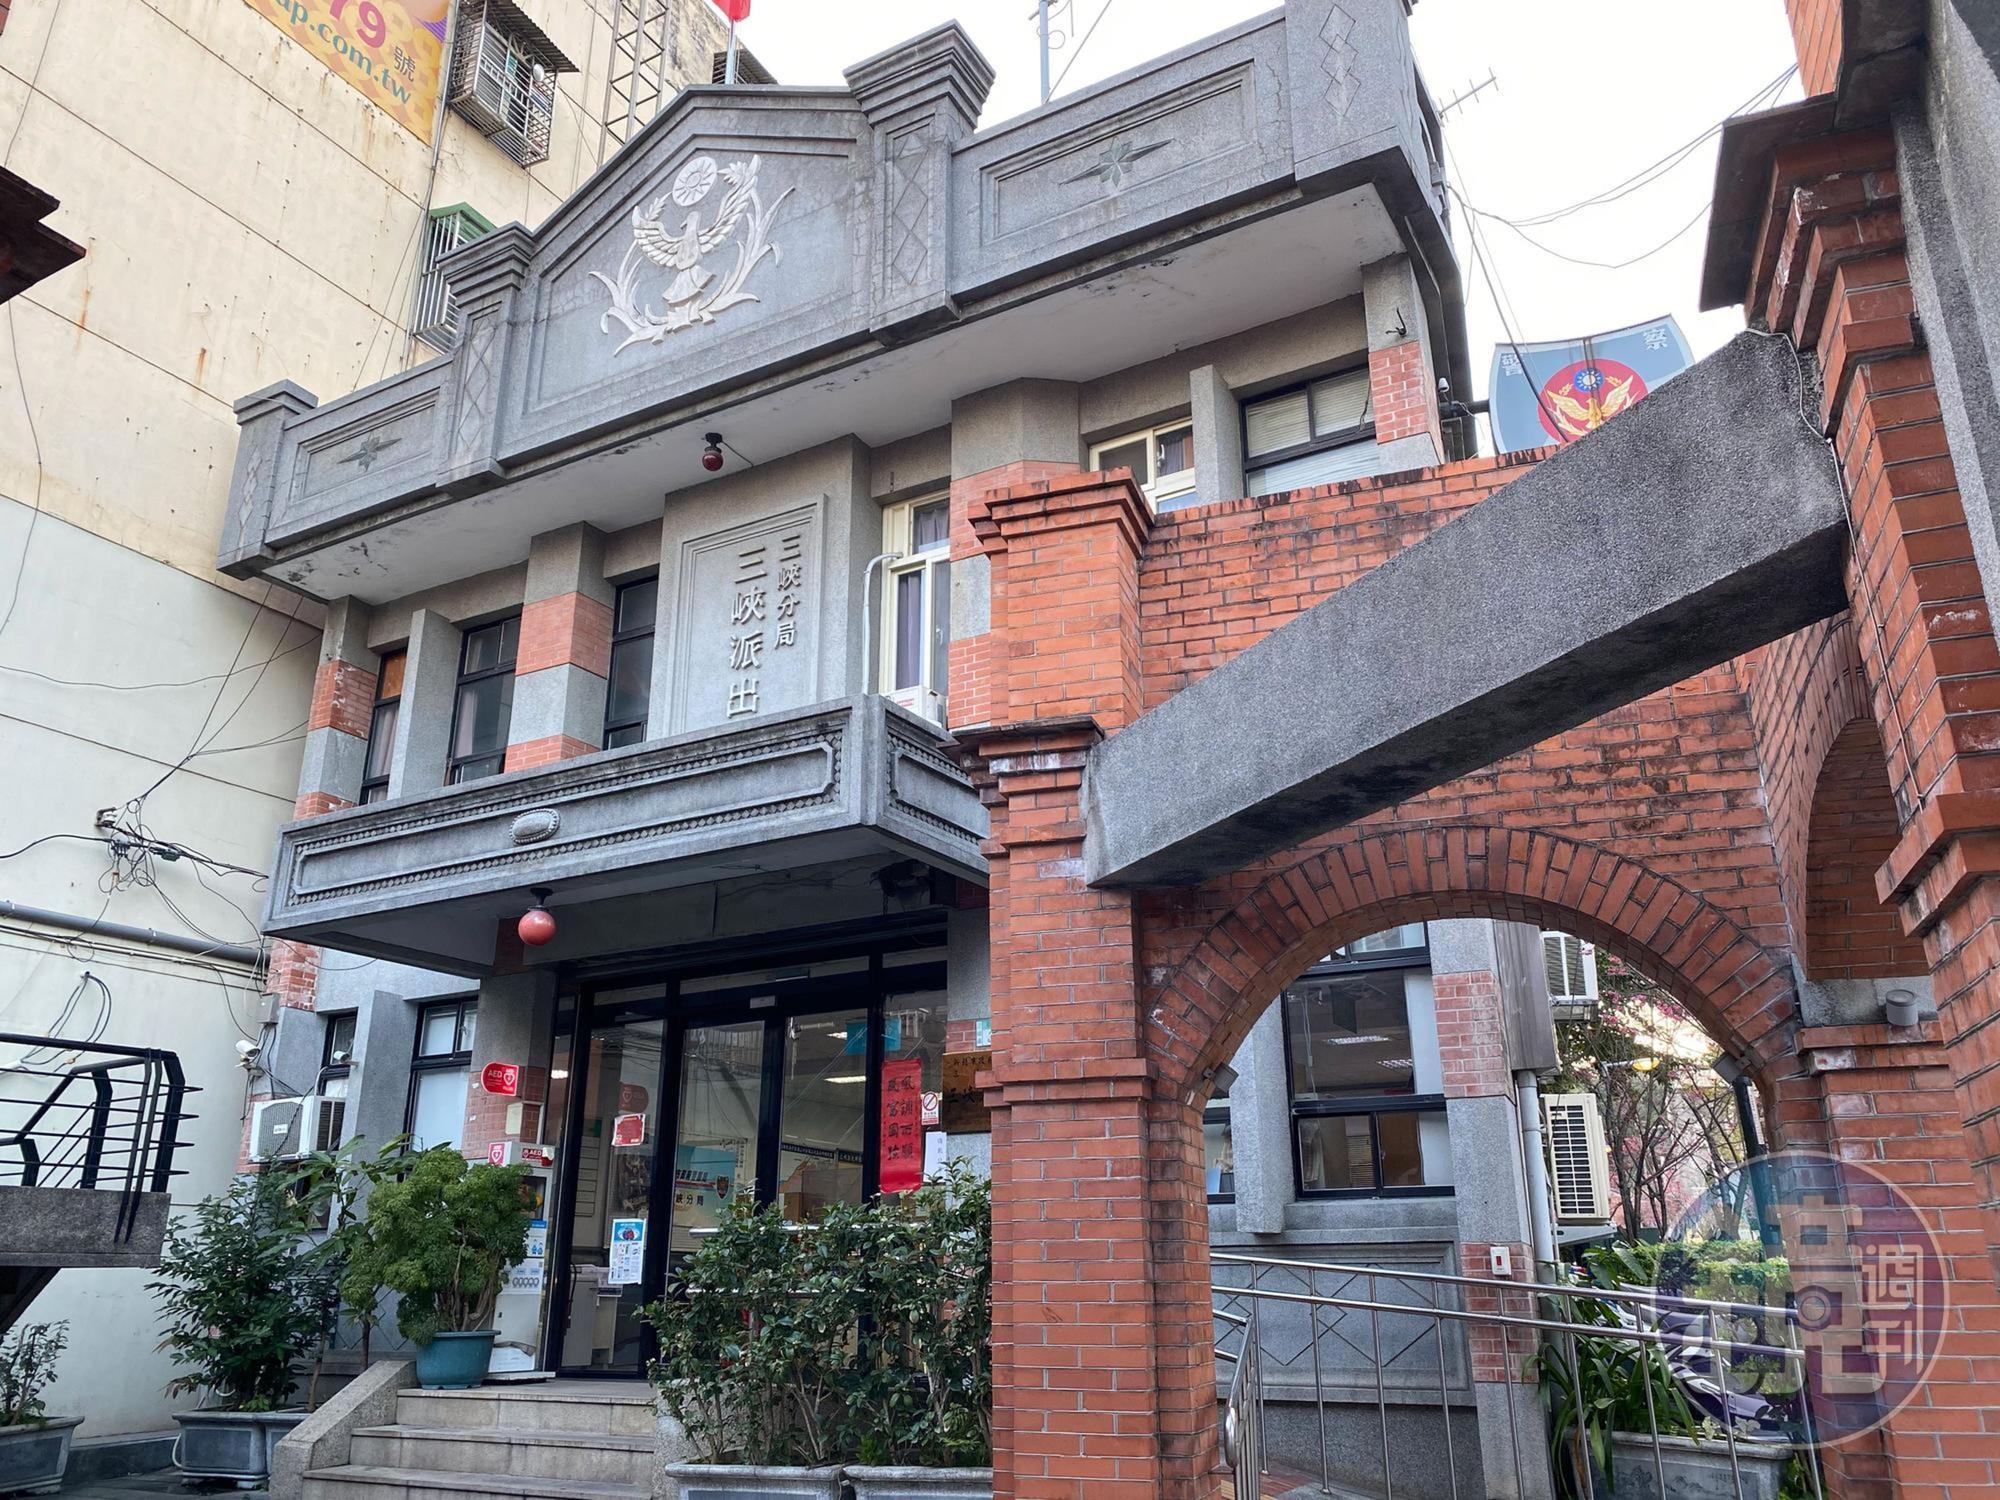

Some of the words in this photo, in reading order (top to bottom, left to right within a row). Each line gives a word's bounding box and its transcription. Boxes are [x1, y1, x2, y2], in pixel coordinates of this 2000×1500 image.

[726, 546, 768, 719] 三峽派出
[774, 535, 802, 650] 三峽分局
[488, 1070, 503, 1079] AED
